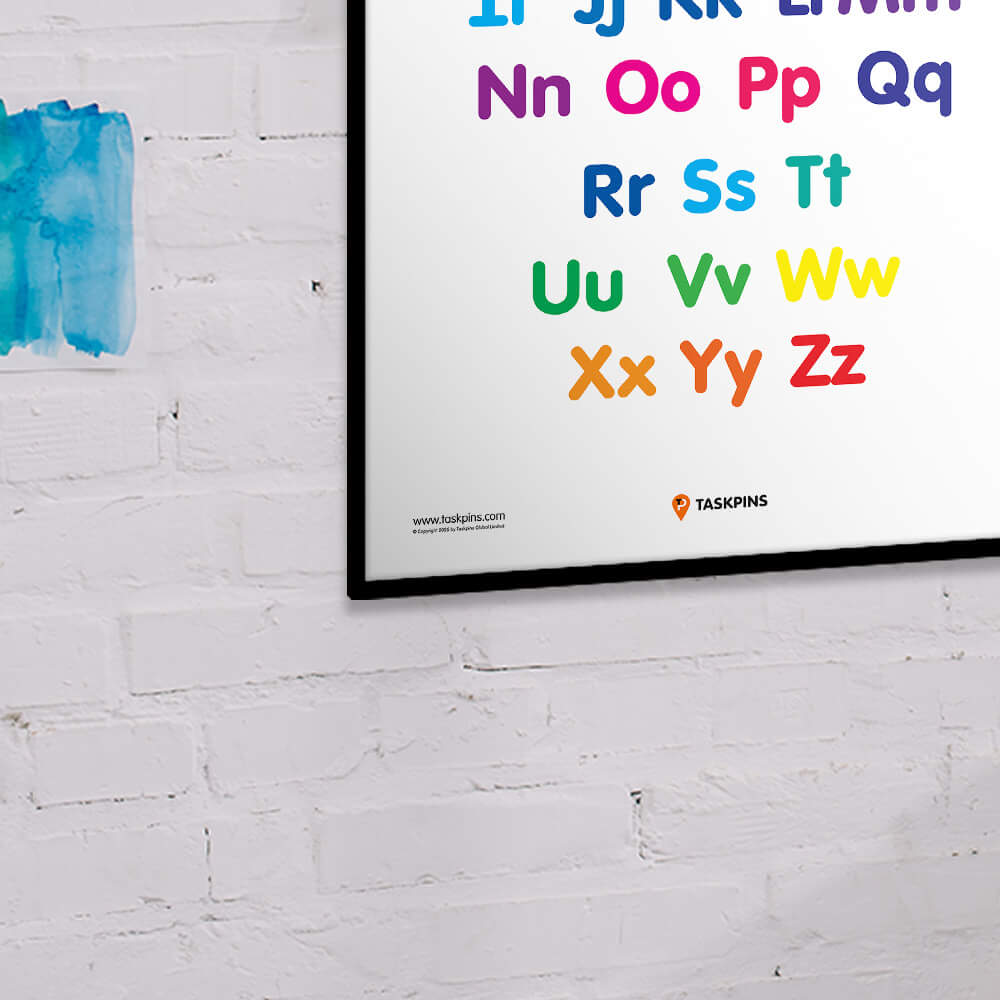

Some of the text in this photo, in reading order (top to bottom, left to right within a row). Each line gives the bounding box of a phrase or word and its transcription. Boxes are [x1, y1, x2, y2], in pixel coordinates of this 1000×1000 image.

[478, 51, 953, 123] Nn Oo Pp Qq
[584, 154, 851, 218] Rr Ss Tt
[533, 247, 900, 315] Uu Vv Ww
[569, 334, 866, 407] Xx Yy Zz
[412, 512, 506, 526] www.taskpins.com
[695, 494, 768, 511] TASKPINS
